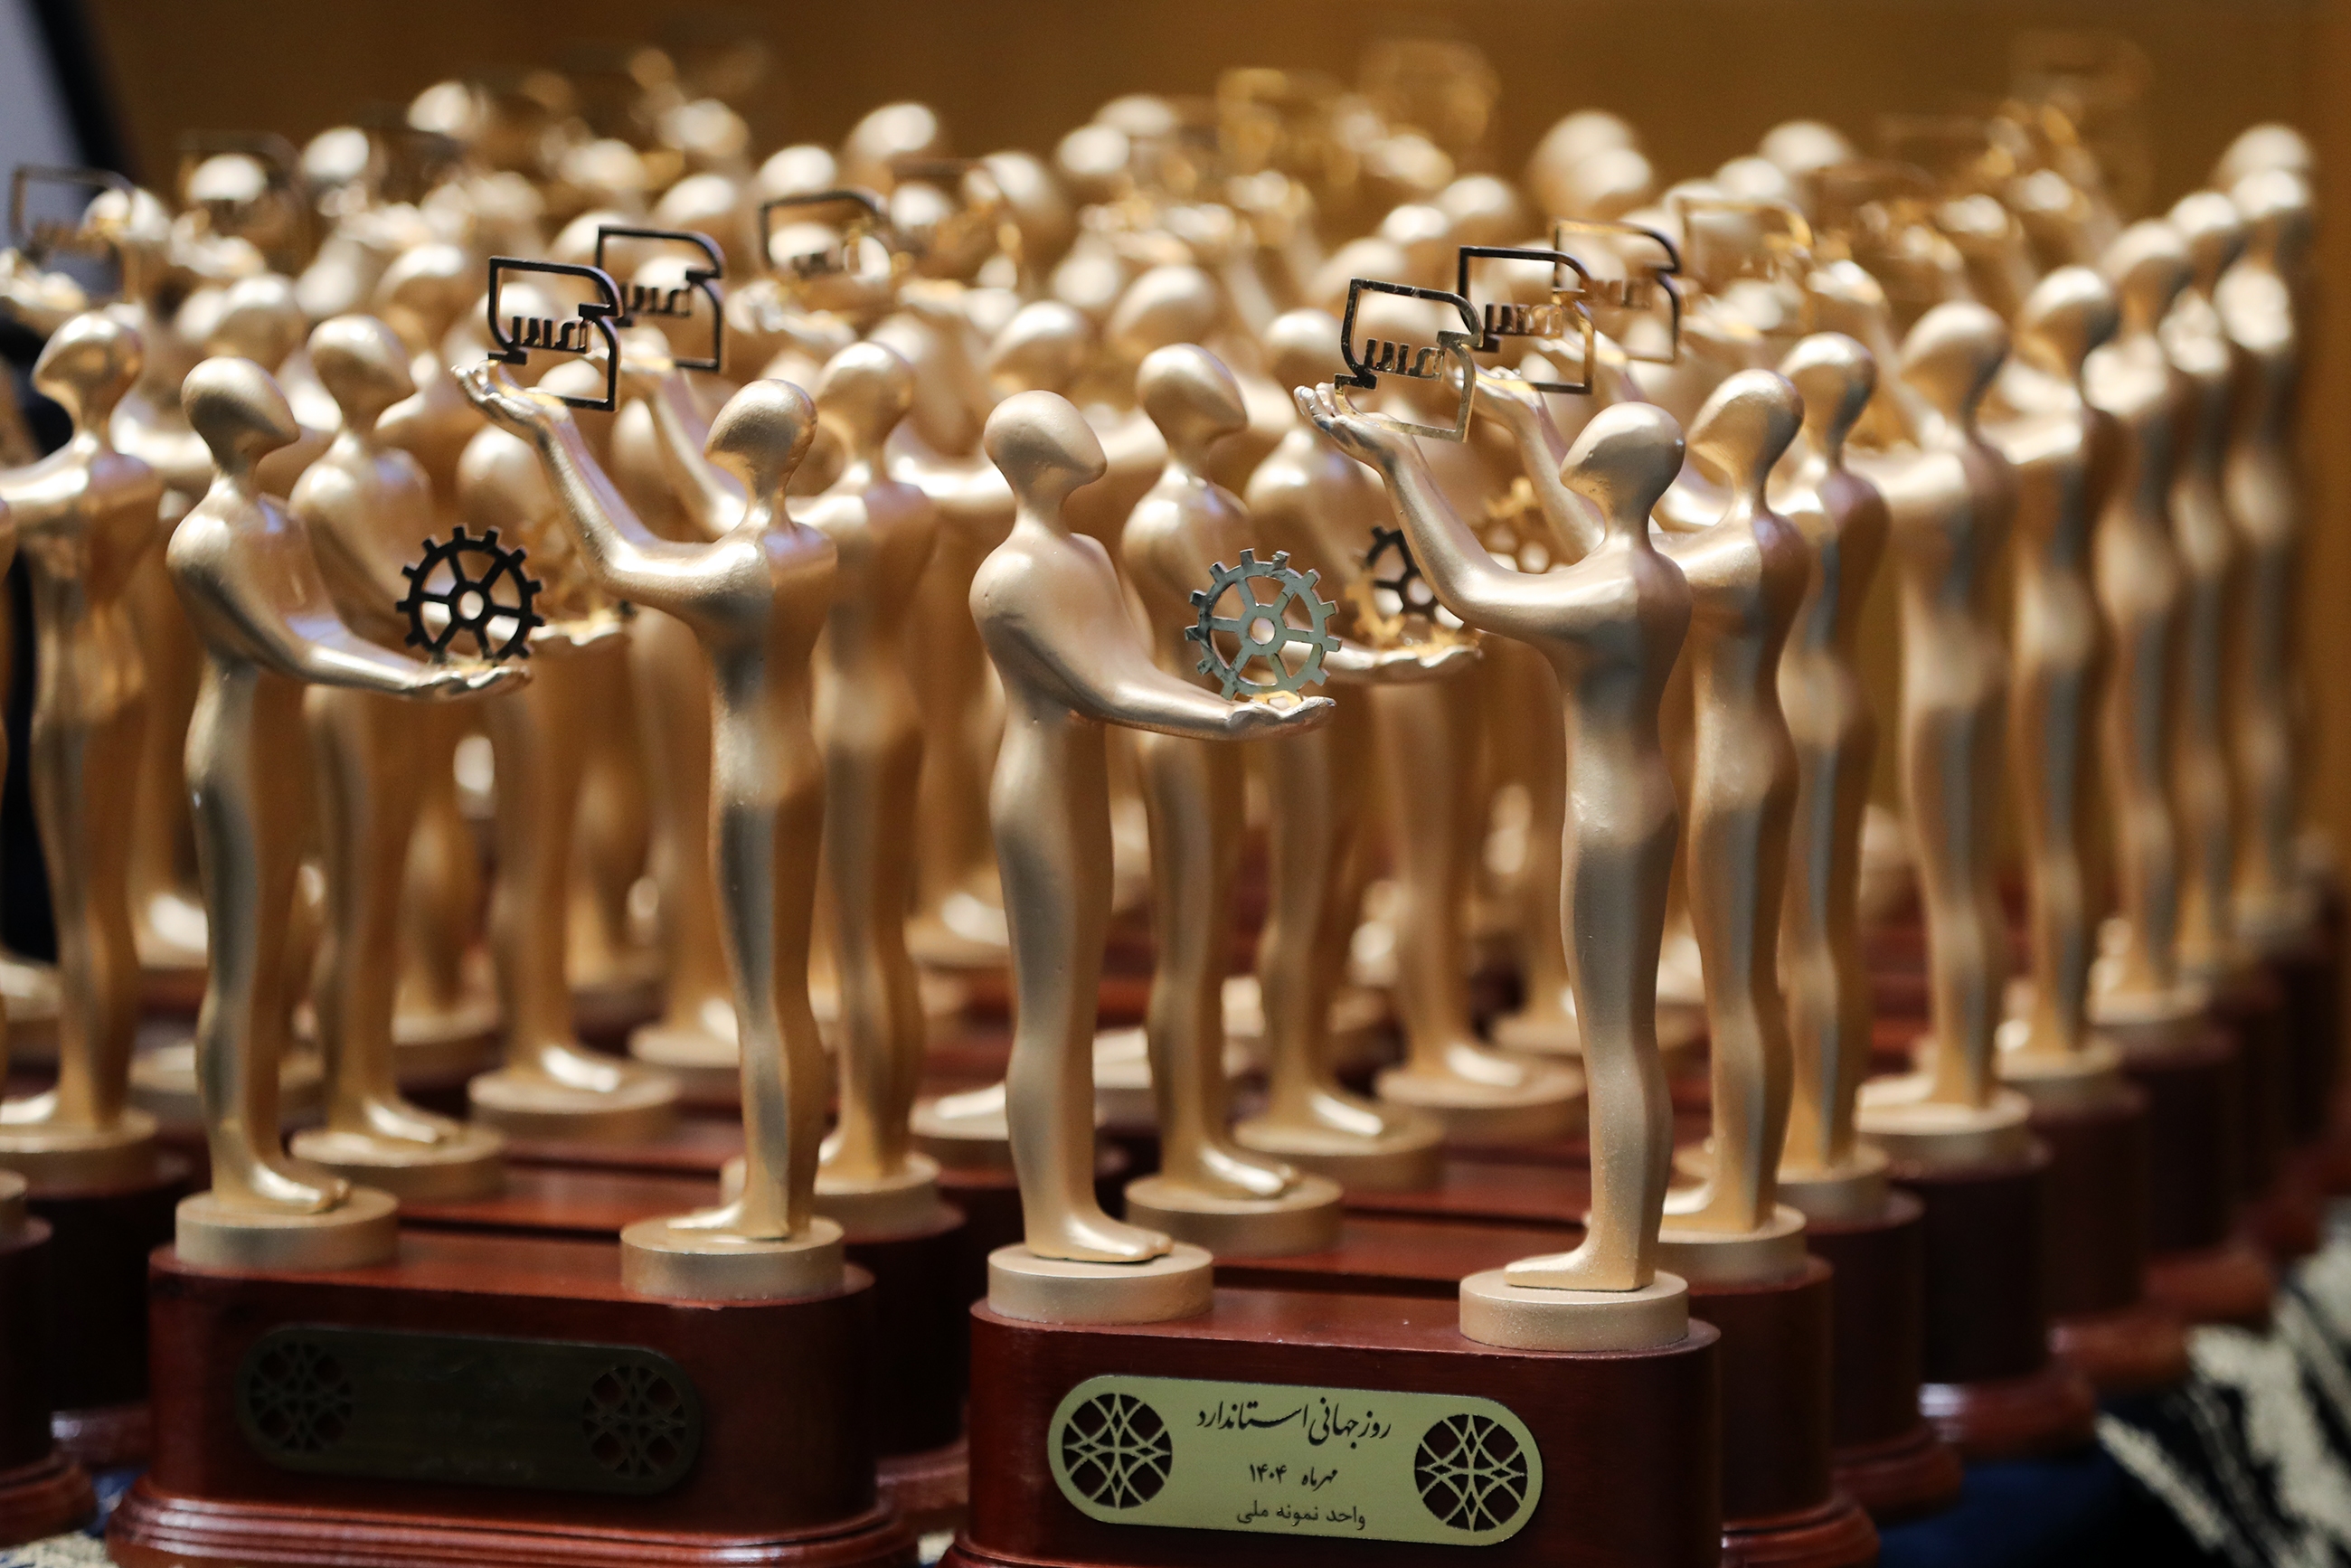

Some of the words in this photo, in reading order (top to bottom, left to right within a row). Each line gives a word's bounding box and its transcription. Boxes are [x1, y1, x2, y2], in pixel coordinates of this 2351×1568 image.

[1196, 1400, 1309, 1431] استاندارد
[1308, 1396, 1359, 1450] جهانی
[1358, 1410, 1392, 1440] روز
[1249, 1463, 1288, 1485] ۱۴۰۴
[1237, 1499, 1270, 1525] ملی
[1276, 1504, 1319, 1527] نمونه
[1326, 1505, 1366, 1531] واحد
